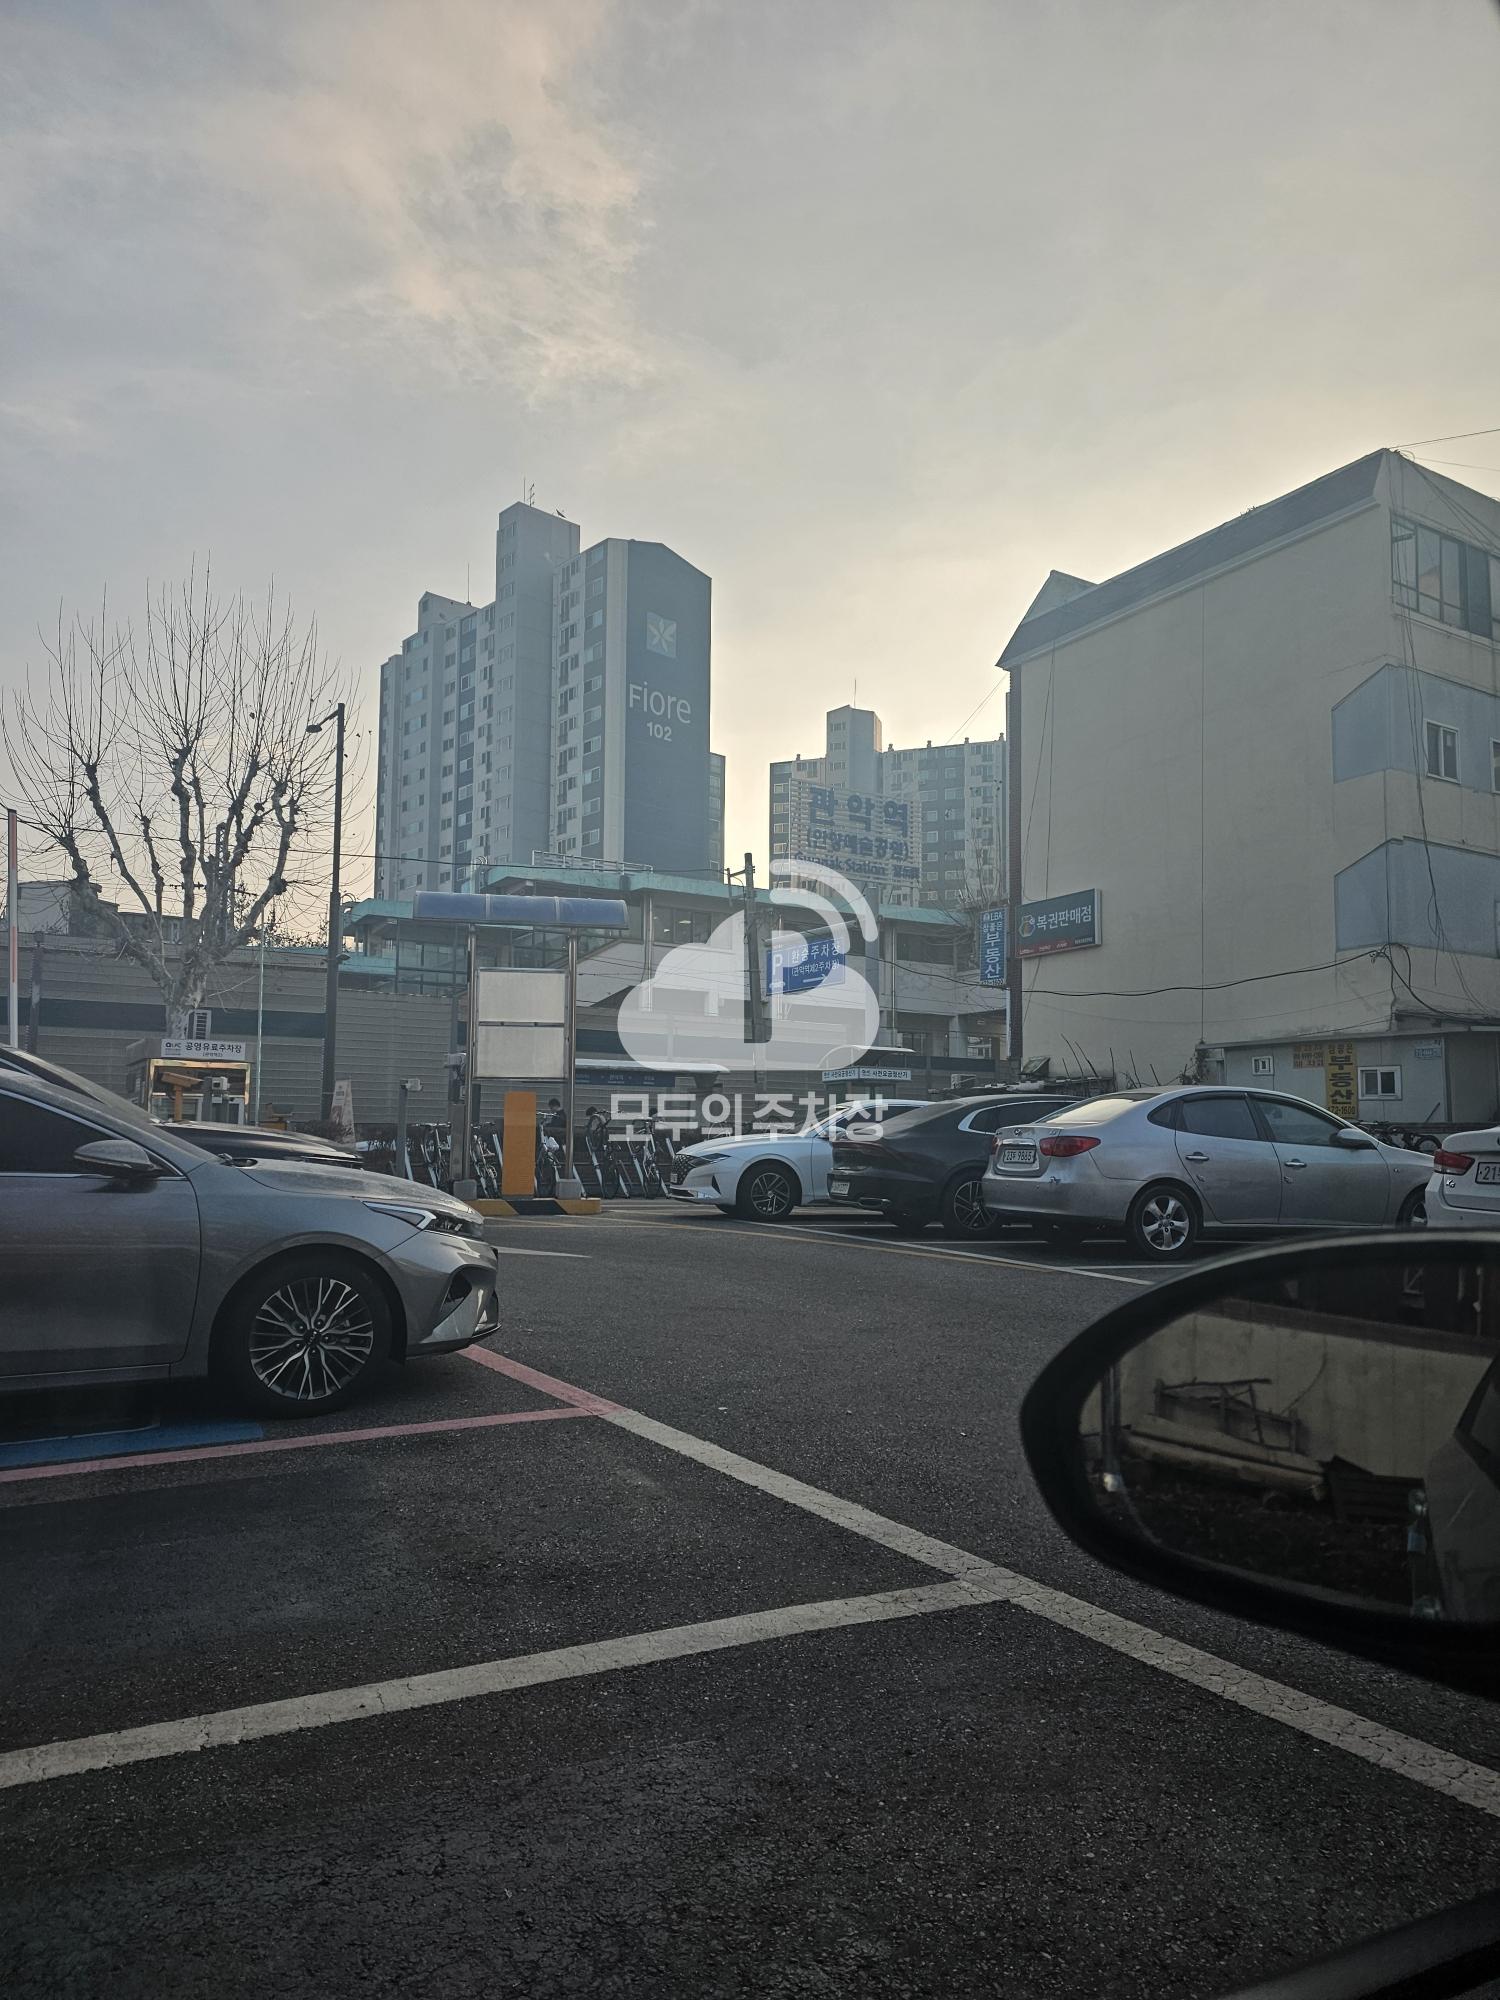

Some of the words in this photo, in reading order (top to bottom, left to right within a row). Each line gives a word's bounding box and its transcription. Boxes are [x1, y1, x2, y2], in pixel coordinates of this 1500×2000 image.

[629, 681, 691, 723] Fiore
[647, 722, 672, 742] 102
[810, 786, 908, 838] 관악역
[845, 858, 886, 876] Station
[1036, 905, 1092, 931] 복권판매점
[791, 942, 841, 964] 환승주차장
[985, 932, 1001, 979] 부동산
[185, 1042, 242, 1054] 공영유료주차장
[872, 1070, 908, 1079] 사전요금정산기
[1328, 1055, 1354, 1105] 부동산
[1483, 1165, 1500, 1180] 21
